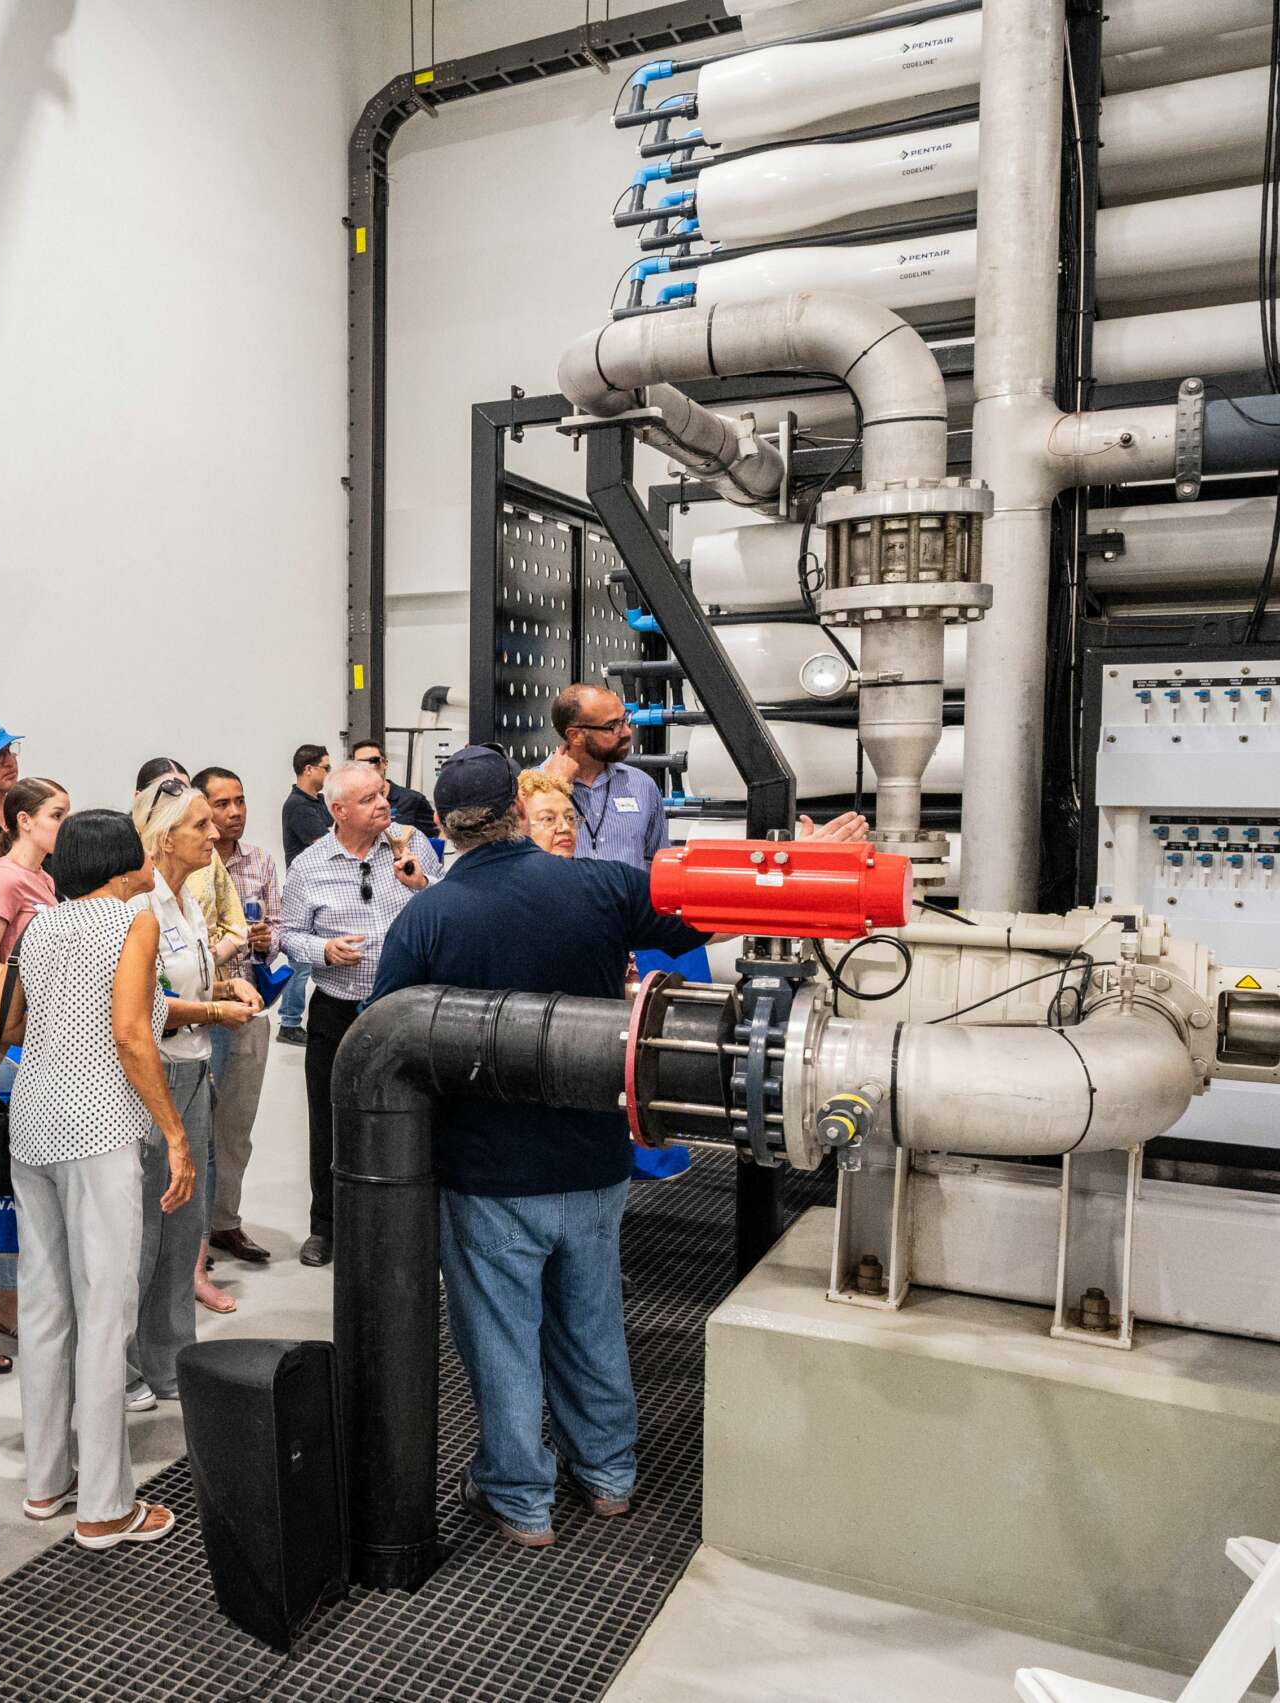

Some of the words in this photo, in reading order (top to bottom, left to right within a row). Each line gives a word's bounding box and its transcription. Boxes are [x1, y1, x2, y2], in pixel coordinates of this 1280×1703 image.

[912, 36, 954, 50] PENTAIR
[910, 143, 952, 156] PENTAIR
[908, 249, 950, 261] PENTAIR
